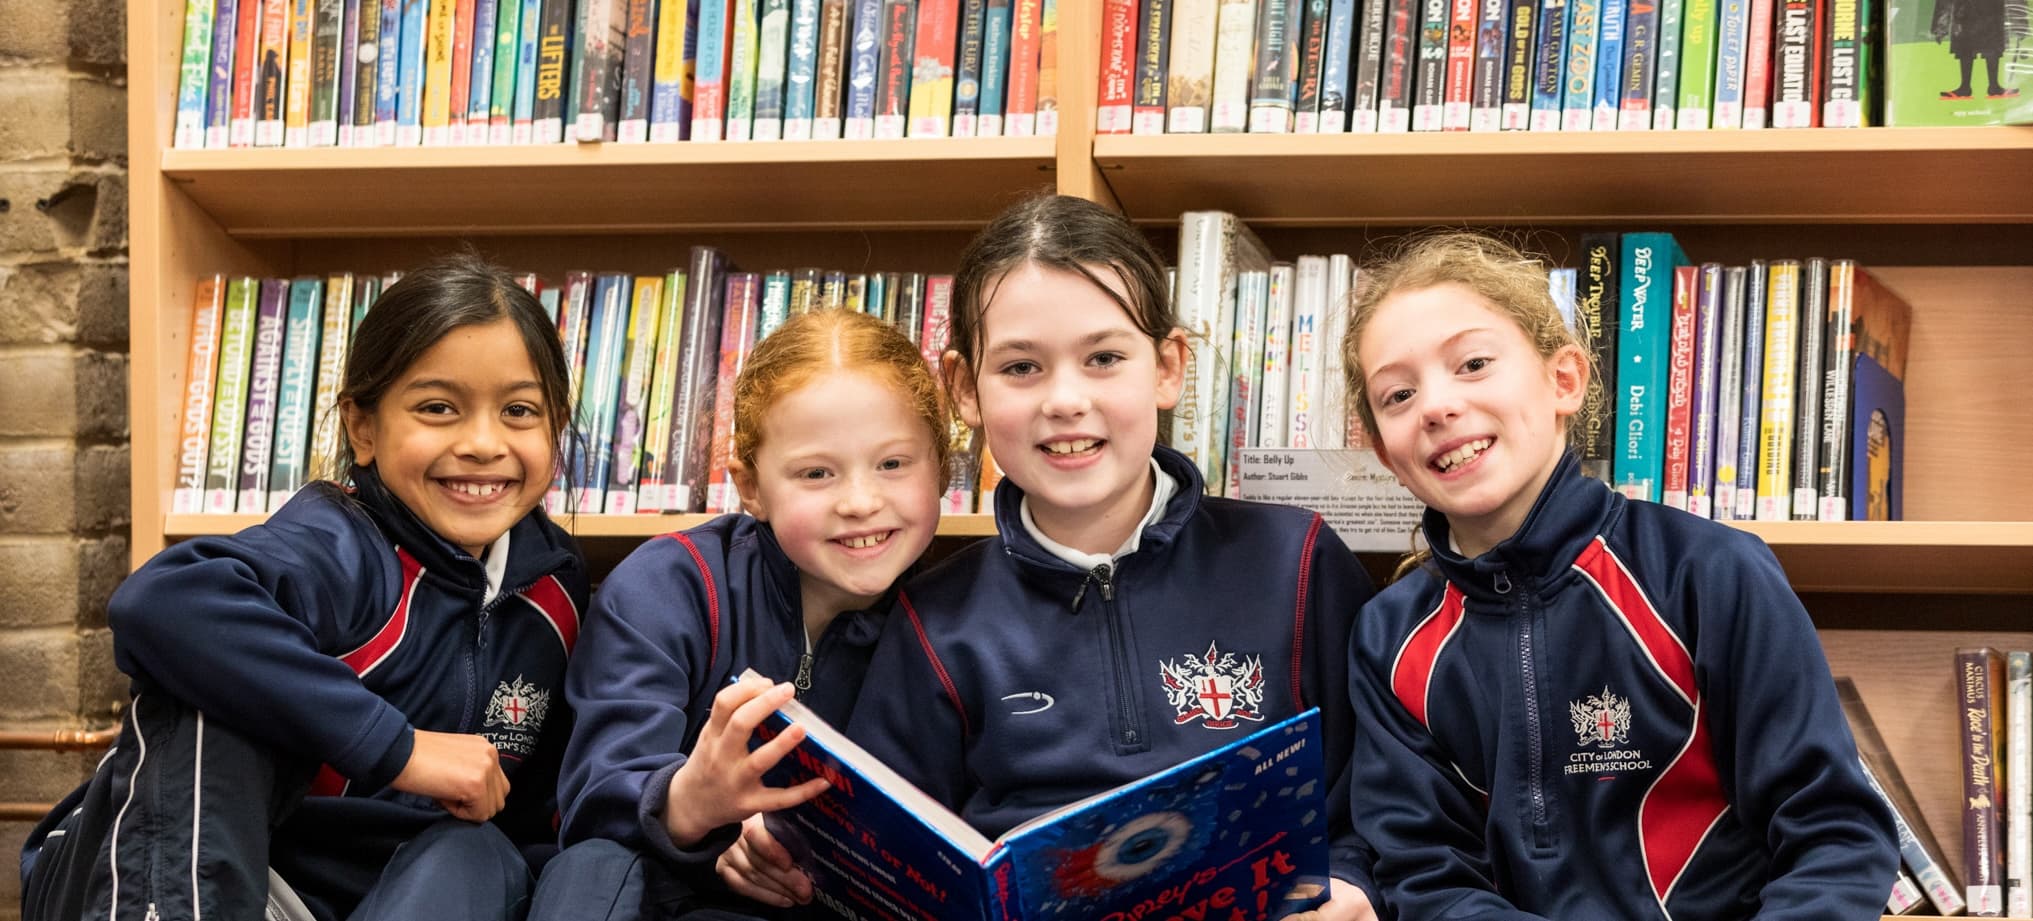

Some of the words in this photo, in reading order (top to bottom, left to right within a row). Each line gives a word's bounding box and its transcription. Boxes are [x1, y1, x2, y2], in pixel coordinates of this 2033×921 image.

[967, 14, 978, 35] THE
[1370, 0, 1384, 30] ERRY
[1427, 0, 1444, 22] ON
[1455, 0, 1472, 21] ON
[1484, 0, 1502, 21] ON
[1514, 6, 1531, 39] GOLD
[1551, 11, 1562, 38] SAM
[1573, 0, 1595, 37] AST
[1690, 0, 1711, 20] lly
[1784, 9, 1807, 45] LAST
[1834, 0, 1857, 41] ORNE
[1267, 20, 1285, 53] LIGHT
[1307, 37, 1322, 62] EYE
[1367, 32, 1381, 61] BLUE
[538, 35, 565, 100] LIFTERS
[964, 40, 978, 73] FURY
[1546, 41, 1560, 93] GAYTON
[1568, 43, 1593, 95] ZOO
[1630, 53, 1645, 91] GEMIN
[1832, 48, 1855, 86] LOST
[1301, 77, 1317, 100] RA
[1509, 65, 1526, 100] GODS
[1590, 246, 1611, 281] DEEP
[1634, 246, 1653, 282] DEEP
[1582, 282, 1604, 338] TROUBLE
[1630, 280, 1651, 331] WATER
[193, 308, 216, 354] WHO
[224, 308, 251, 383] BEYOND
[252, 315, 279, 404] AGAINST
[285, 318, 313, 391] SIMPLY
[185, 380, 209, 435] GODS
[1630, 385, 1645, 415] Debi
[1823, 369, 1837, 421] WILLESDEN
[211, 399, 240, 479] ODYSSEY
[243, 421, 267, 475] GODS
[277, 406, 305, 466] QUEST
[1586, 414, 1602, 458] Gliori
[1628, 419, 1645, 459] Gliori
[1823, 423, 1835, 443] LANE
[1243, 454, 1260, 464] Title:
[1264, 454, 1281, 466] Belly
[1284, 455, 1294, 466] Up
[1243, 472, 1266, 480] Author:
[1268, 472, 1289, 480] Stuart
[1290, 472, 1308, 480] Gibbs
[1965, 662, 1977, 704] MAXIMUS
[1974, 665, 1985, 699] CIRCUS
[1966, 707, 1987, 734] Race
[1254, 758, 1275, 775] ALL
[1276, 738, 1307, 763] NEW!
[1564, 762, 1610, 775] FREEMEN'S
[1610, 760, 1653, 772] SCHOOL
[1570, 752, 1595, 762] CITY
[1604, 750, 1641, 760] LONDON
[1971, 755, 1991, 786] Death
[1252, 849, 1298, 891] It
